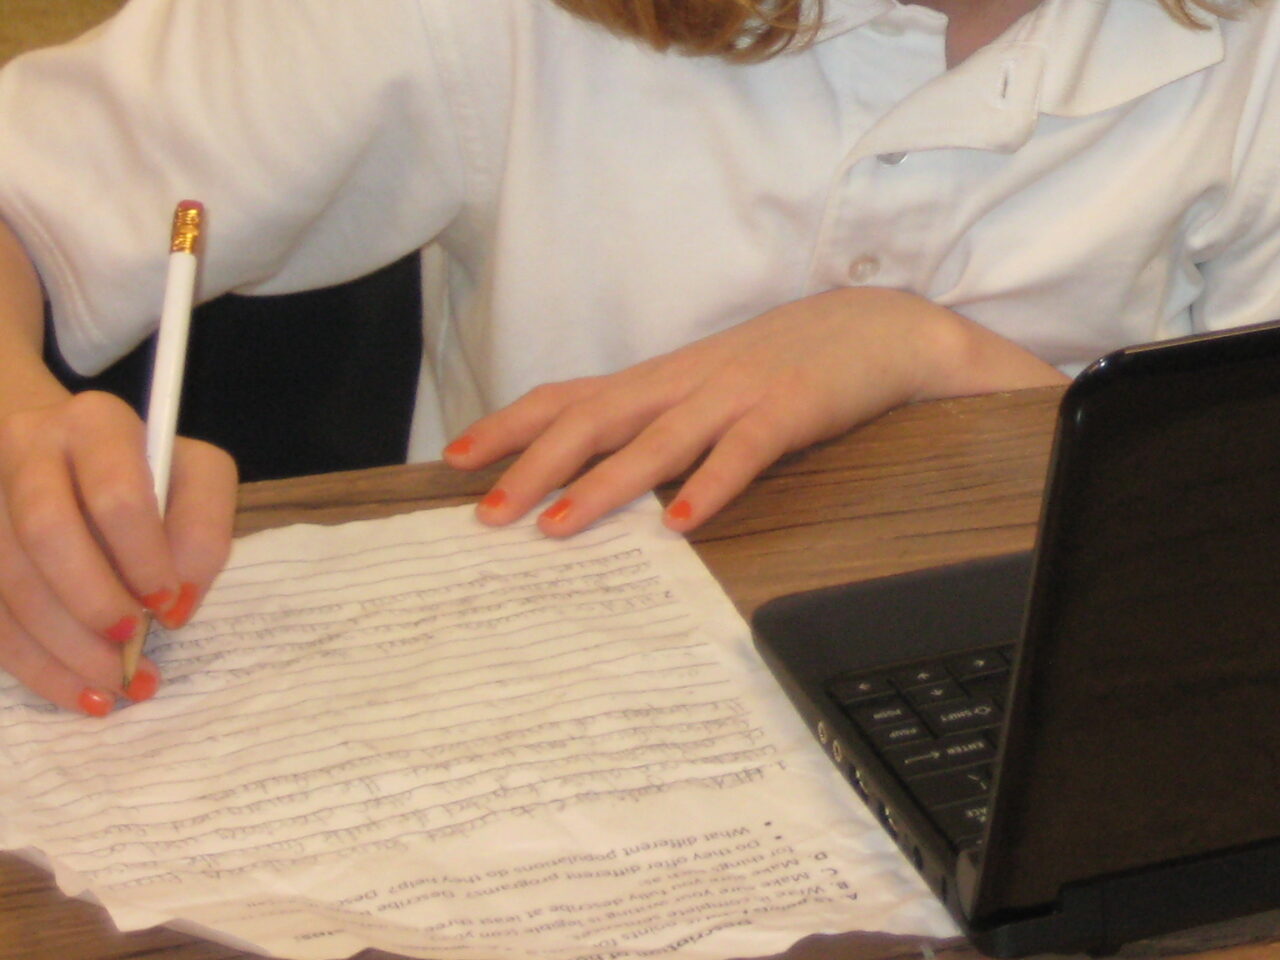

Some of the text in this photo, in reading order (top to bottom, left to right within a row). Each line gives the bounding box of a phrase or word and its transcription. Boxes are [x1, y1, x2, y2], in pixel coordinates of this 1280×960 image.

[941, 709, 973, 722] SHIFT
[946, 741, 985, 755] ENTER
[702, 825, 751, 844] What
[621, 835, 698, 856] different
[735, 838, 760, 853] Do
[692, 846, 732, 863] they
[565, 864, 641, 882] different
[647, 856, 688, 873] offer
[752, 857, 799, 877] Make
[438, 872, 482, 887] they
[485, 868, 509, 881] do
[762, 871, 809, 889] Make
